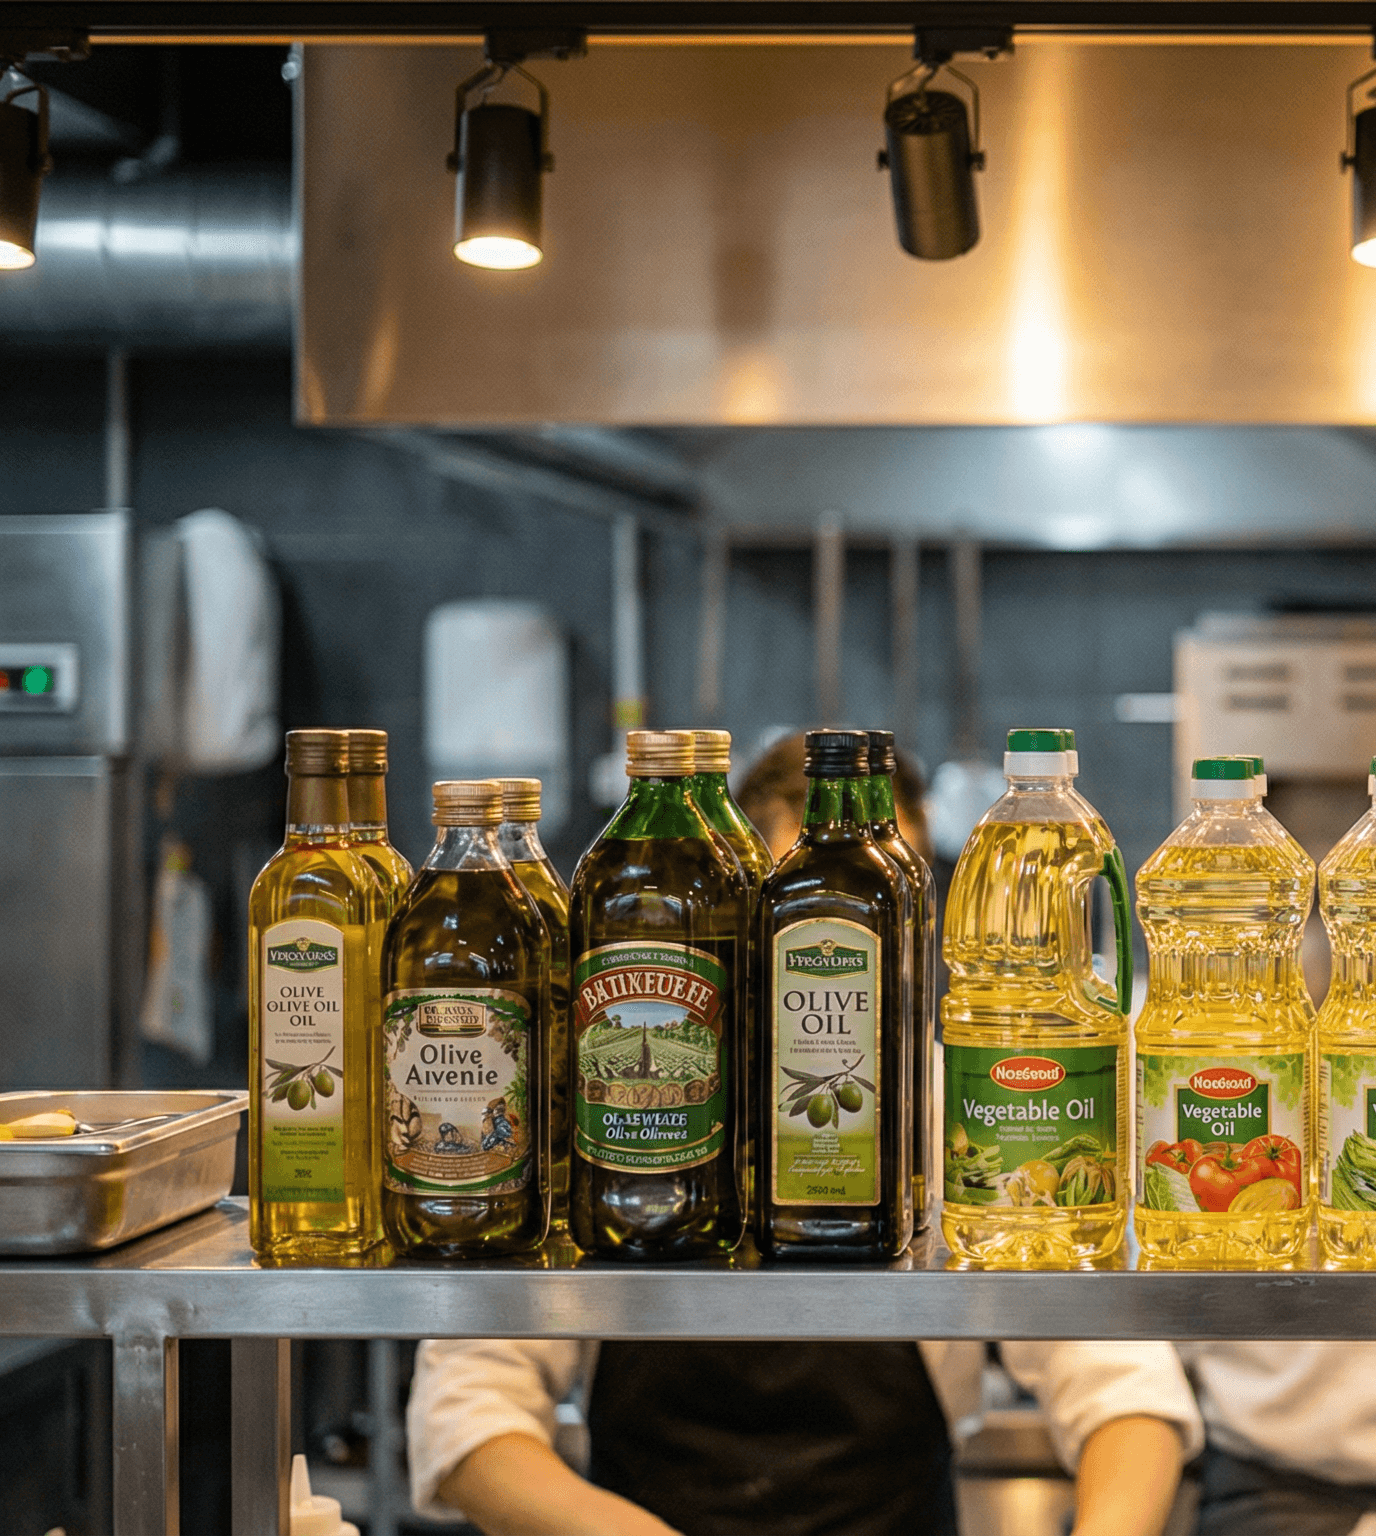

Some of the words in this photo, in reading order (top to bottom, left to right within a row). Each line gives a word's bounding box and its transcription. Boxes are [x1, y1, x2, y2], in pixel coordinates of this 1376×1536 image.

[280, 986, 325, 998] OLIVE
[783, 990, 869, 1012] OLIVE
[266, 1000, 310, 1012] OLIVE
[313, 1000, 340, 1012] OIL
[289, 1014, 317, 1027] OIL
[801, 1013, 851, 1035] OIL
[420, 1043, 482, 1065] Olive
[963, 1098, 1060, 1127] Vegetable
[1066, 1097, 1094, 1121] Oil
[1182, 1102, 1262, 1124] Vegetable
[1211, 1121, 1235, 1136] Oil
